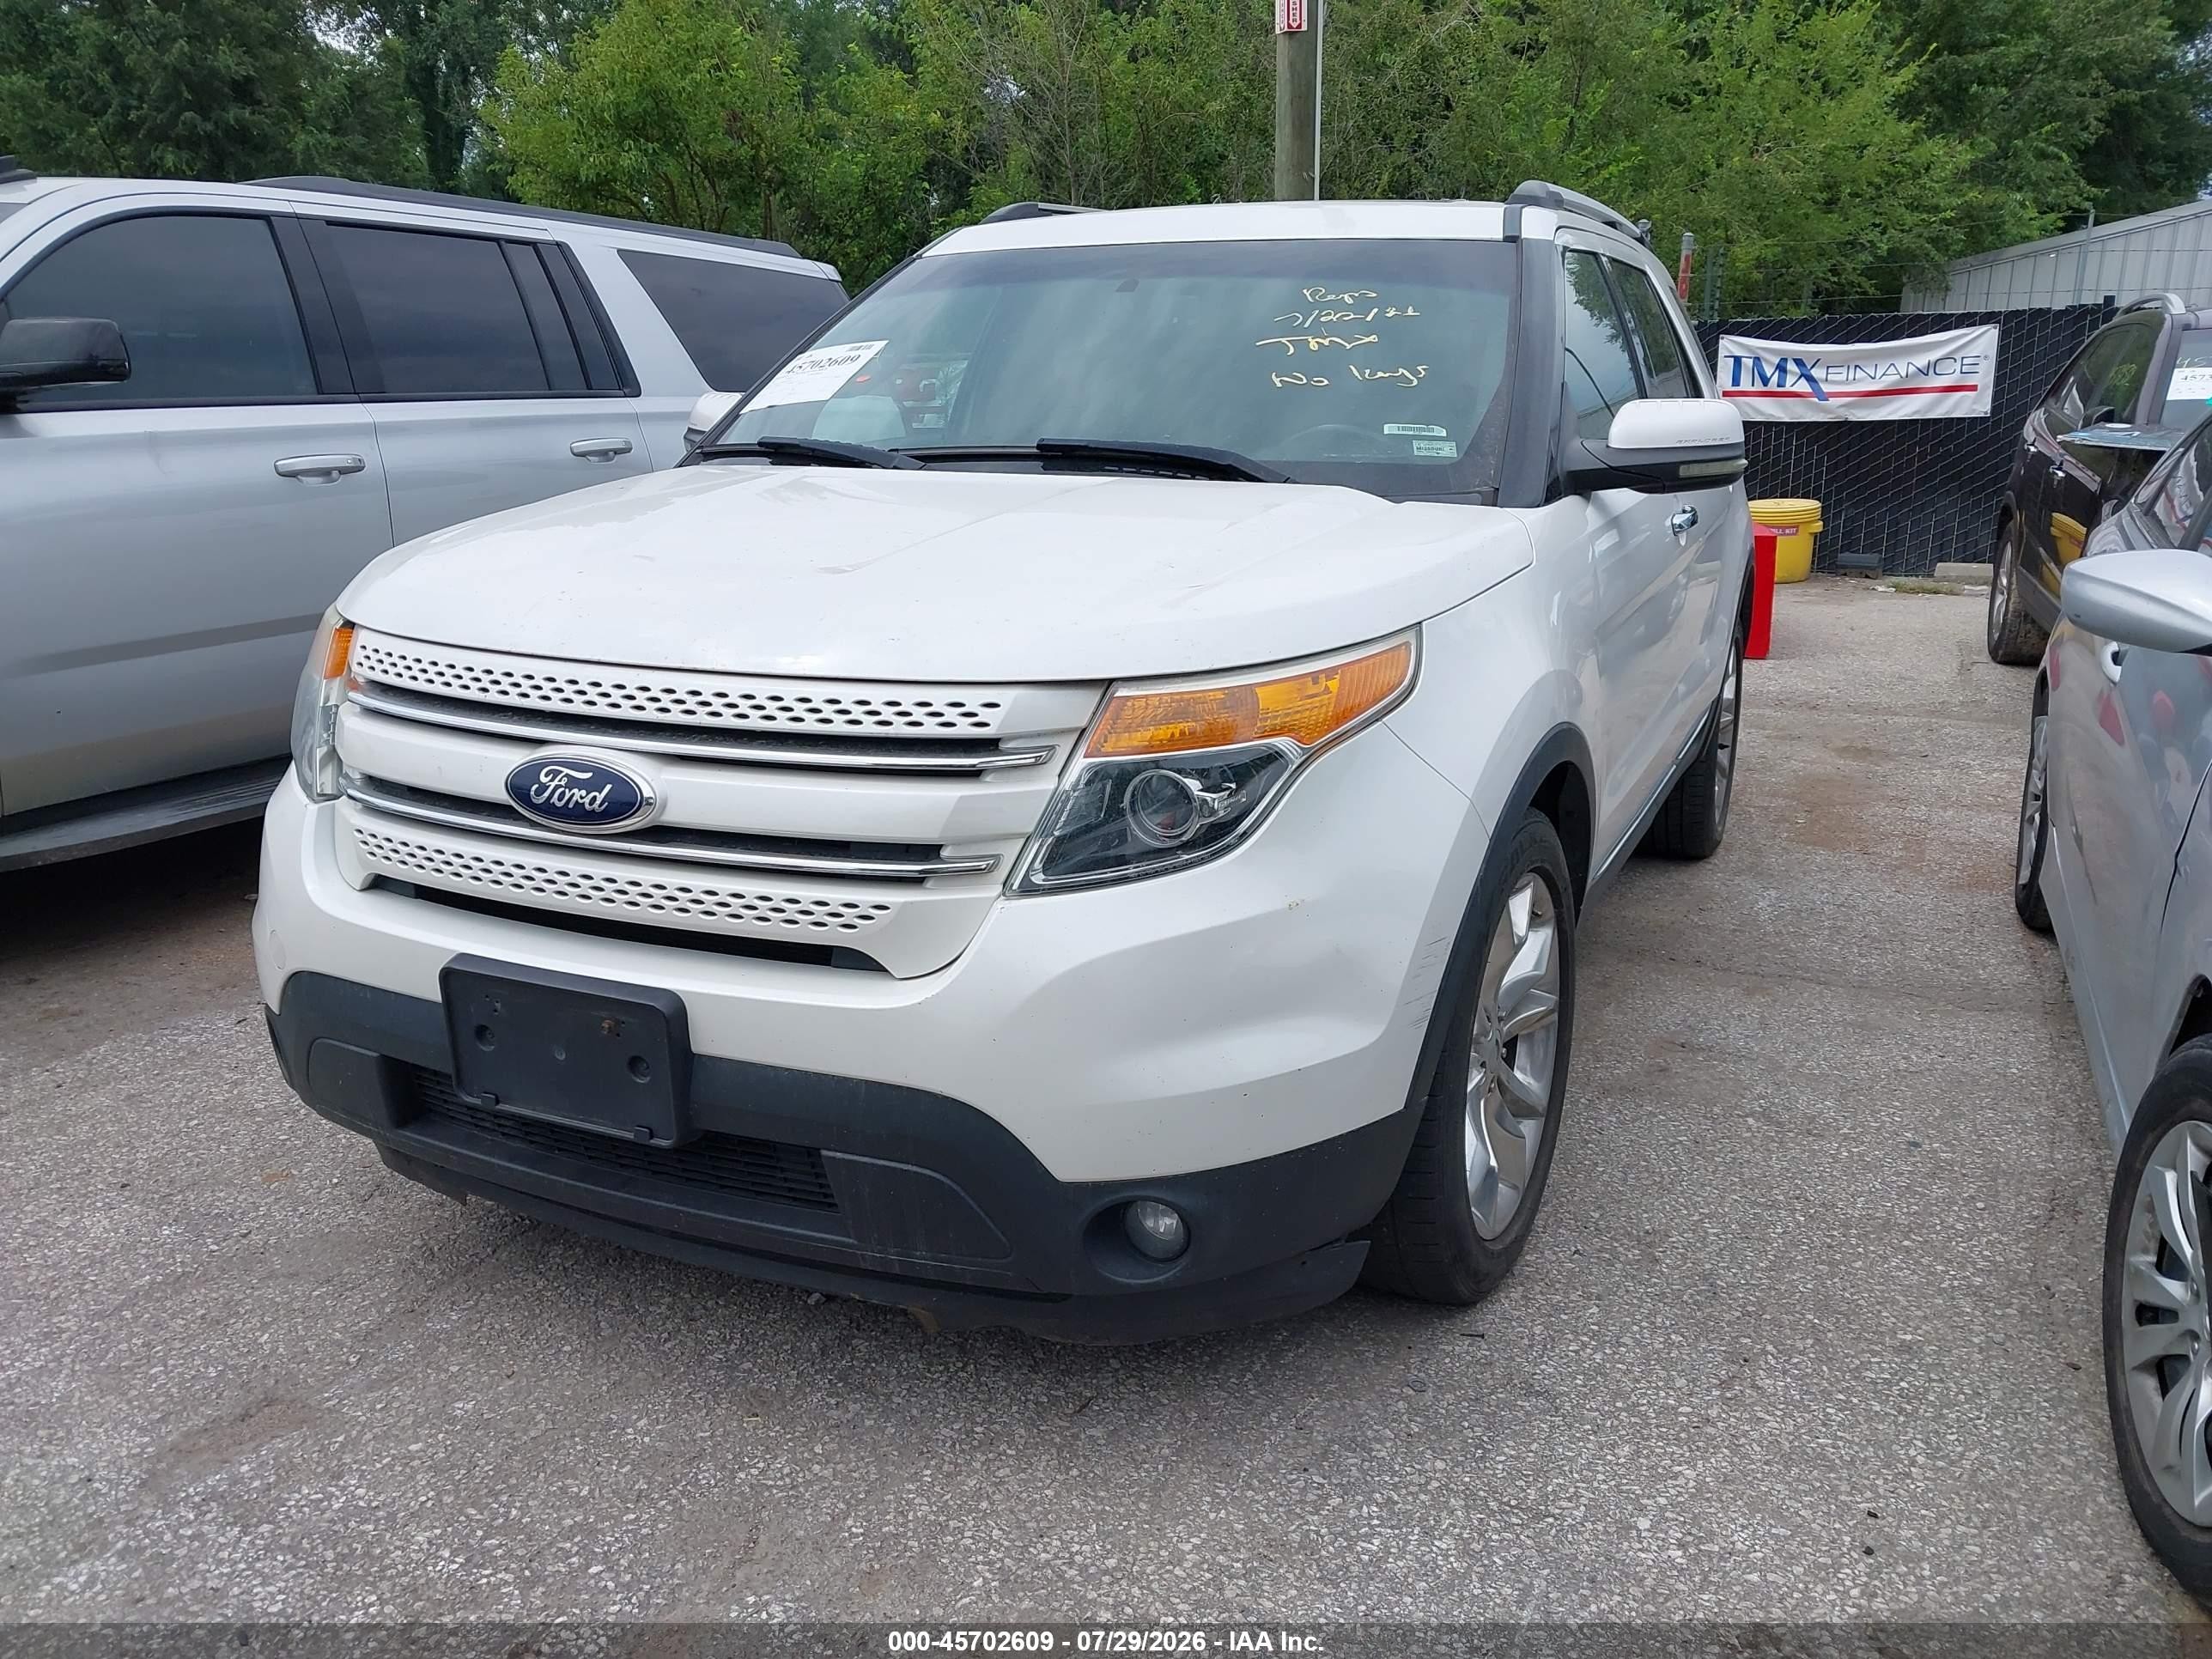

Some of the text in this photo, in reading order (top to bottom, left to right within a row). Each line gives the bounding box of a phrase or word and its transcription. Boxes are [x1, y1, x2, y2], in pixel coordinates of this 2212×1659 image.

[1723, 354, 1981, 402] TMX FINANCE
[530, 765, 613, 812] Ford
